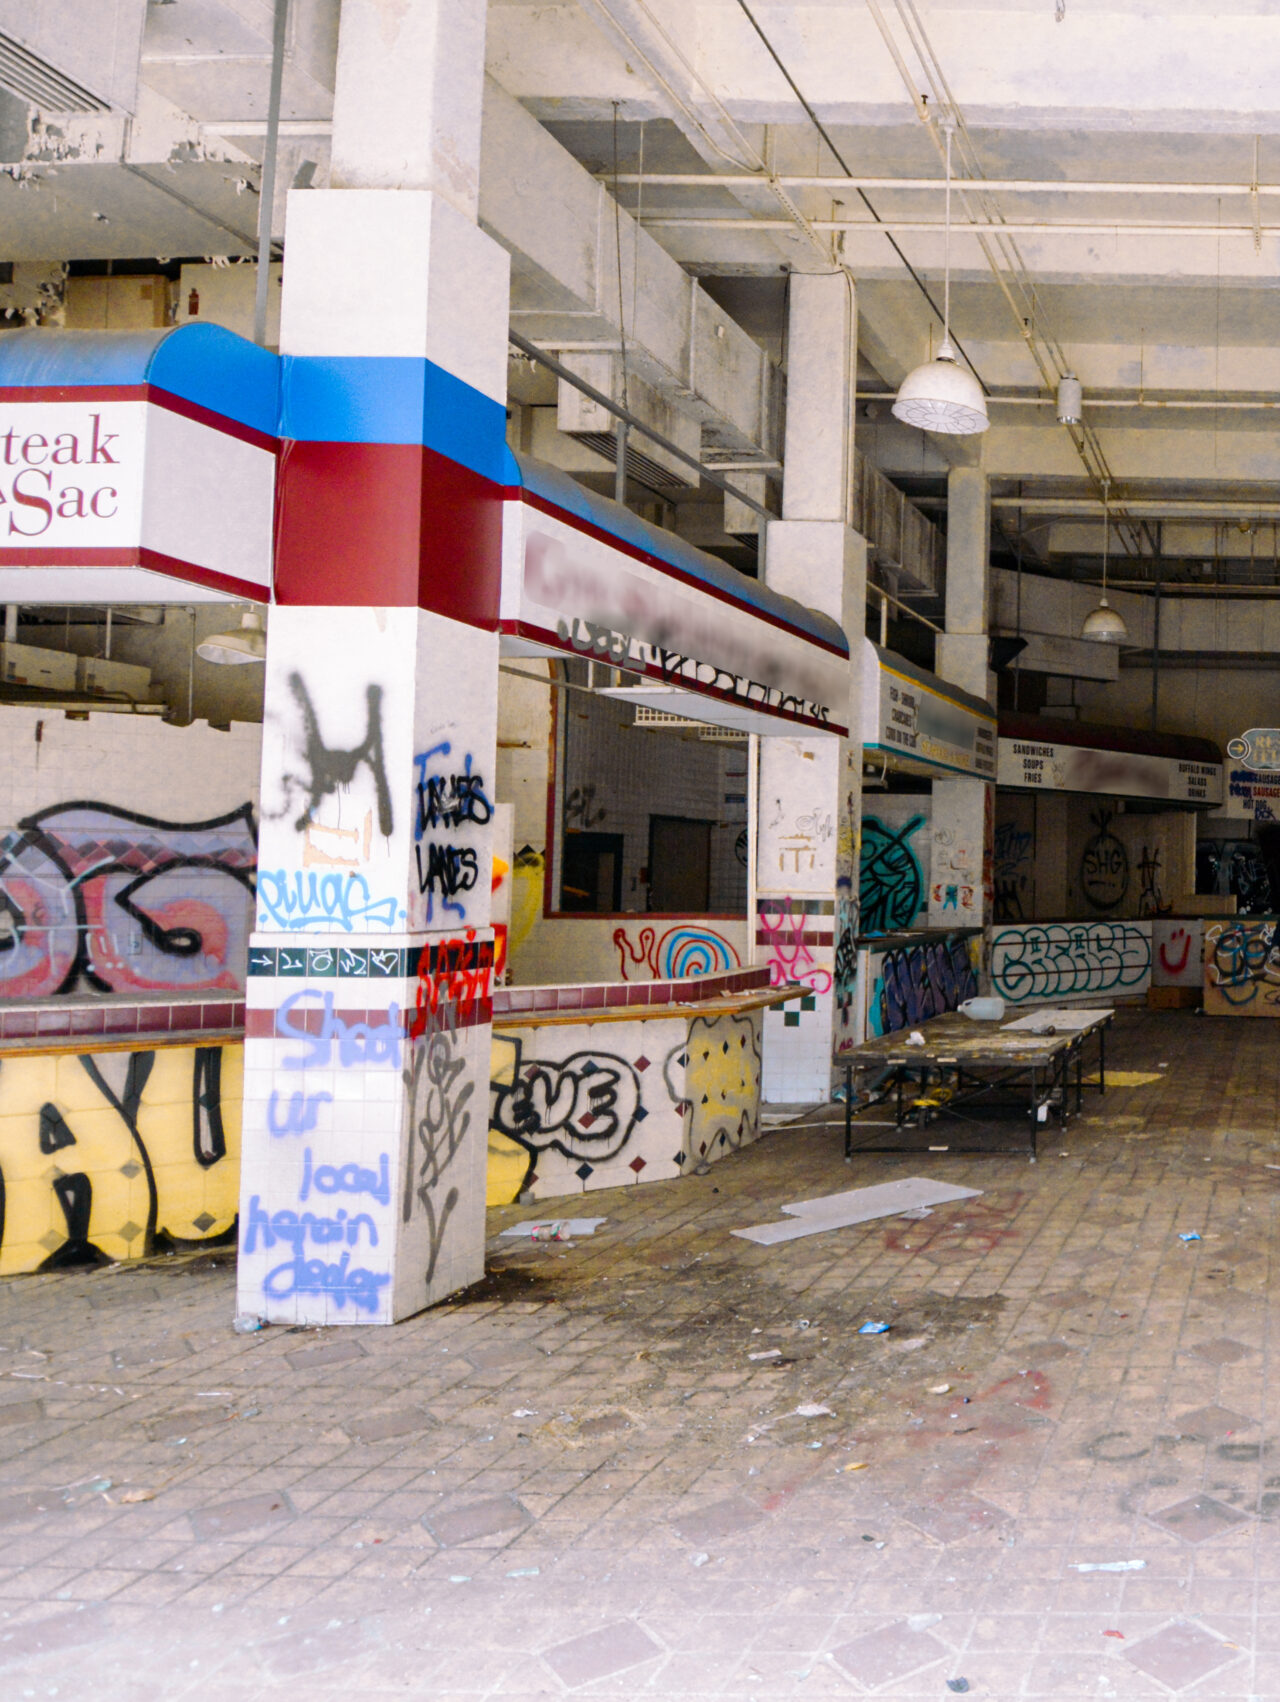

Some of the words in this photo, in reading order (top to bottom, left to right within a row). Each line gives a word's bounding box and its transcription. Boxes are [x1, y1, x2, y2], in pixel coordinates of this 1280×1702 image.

[8, 468, 119, 537] Sac
[1013, 744, 1054, 757] SANDWICHES
[1023, 758, 1044, 770] SOUPS
[1178, 763, 1200, 774] BUFFALO
[1201, 765, 1216, 776] WINGS
[1024, 772, 1042, 783] FRIES
[1188, 776, 1207, 787] SALADS
[1188, 788, 1206, 799] DRINKS
[1253, 786, 1280, 798] SAUSAGE
[1243, 799, 1254, 809] HOT
[299, 1146, 391, 1207] local
